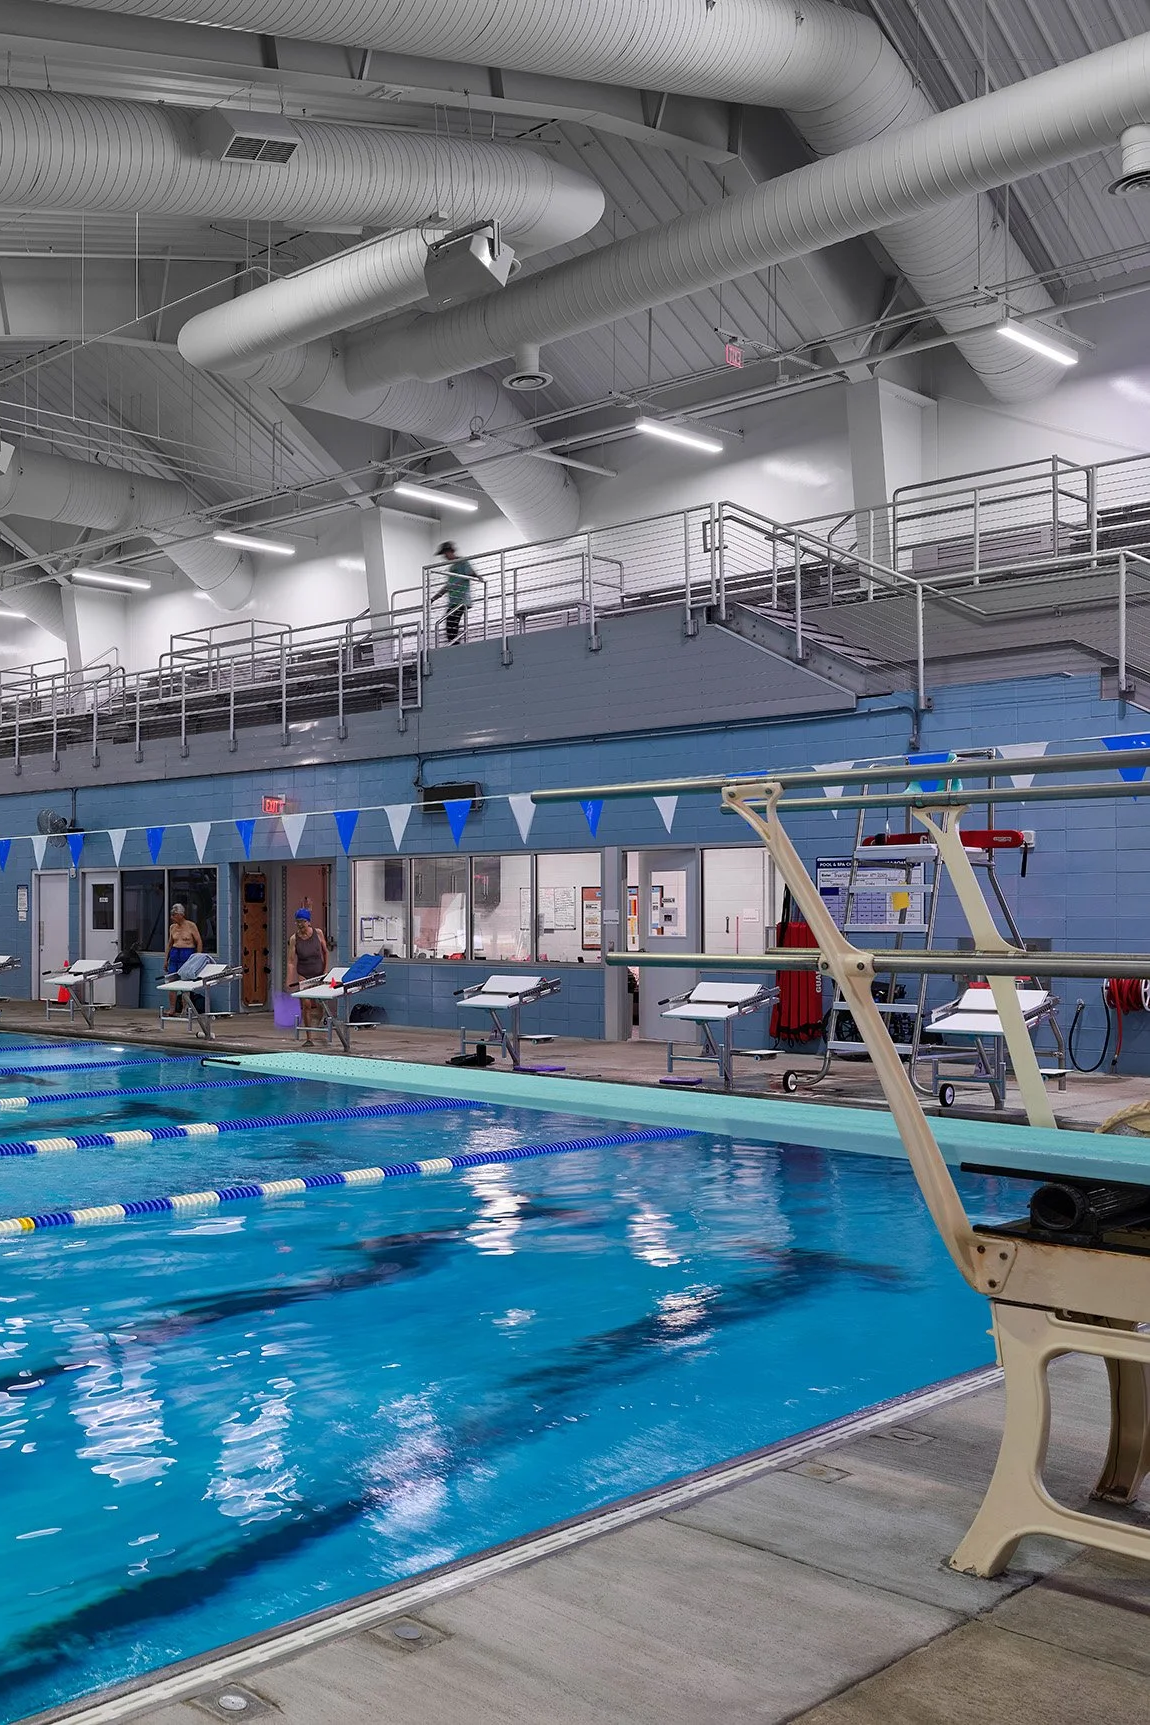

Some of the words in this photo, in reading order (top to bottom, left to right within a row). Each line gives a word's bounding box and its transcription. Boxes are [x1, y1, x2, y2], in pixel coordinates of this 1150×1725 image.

[265, 799, 279, 813] EXIT
[323, 1016, 328, 1026] 6
[705, 1043, 710, 1054] 8
[978, 1061, 983, 1073] 9
